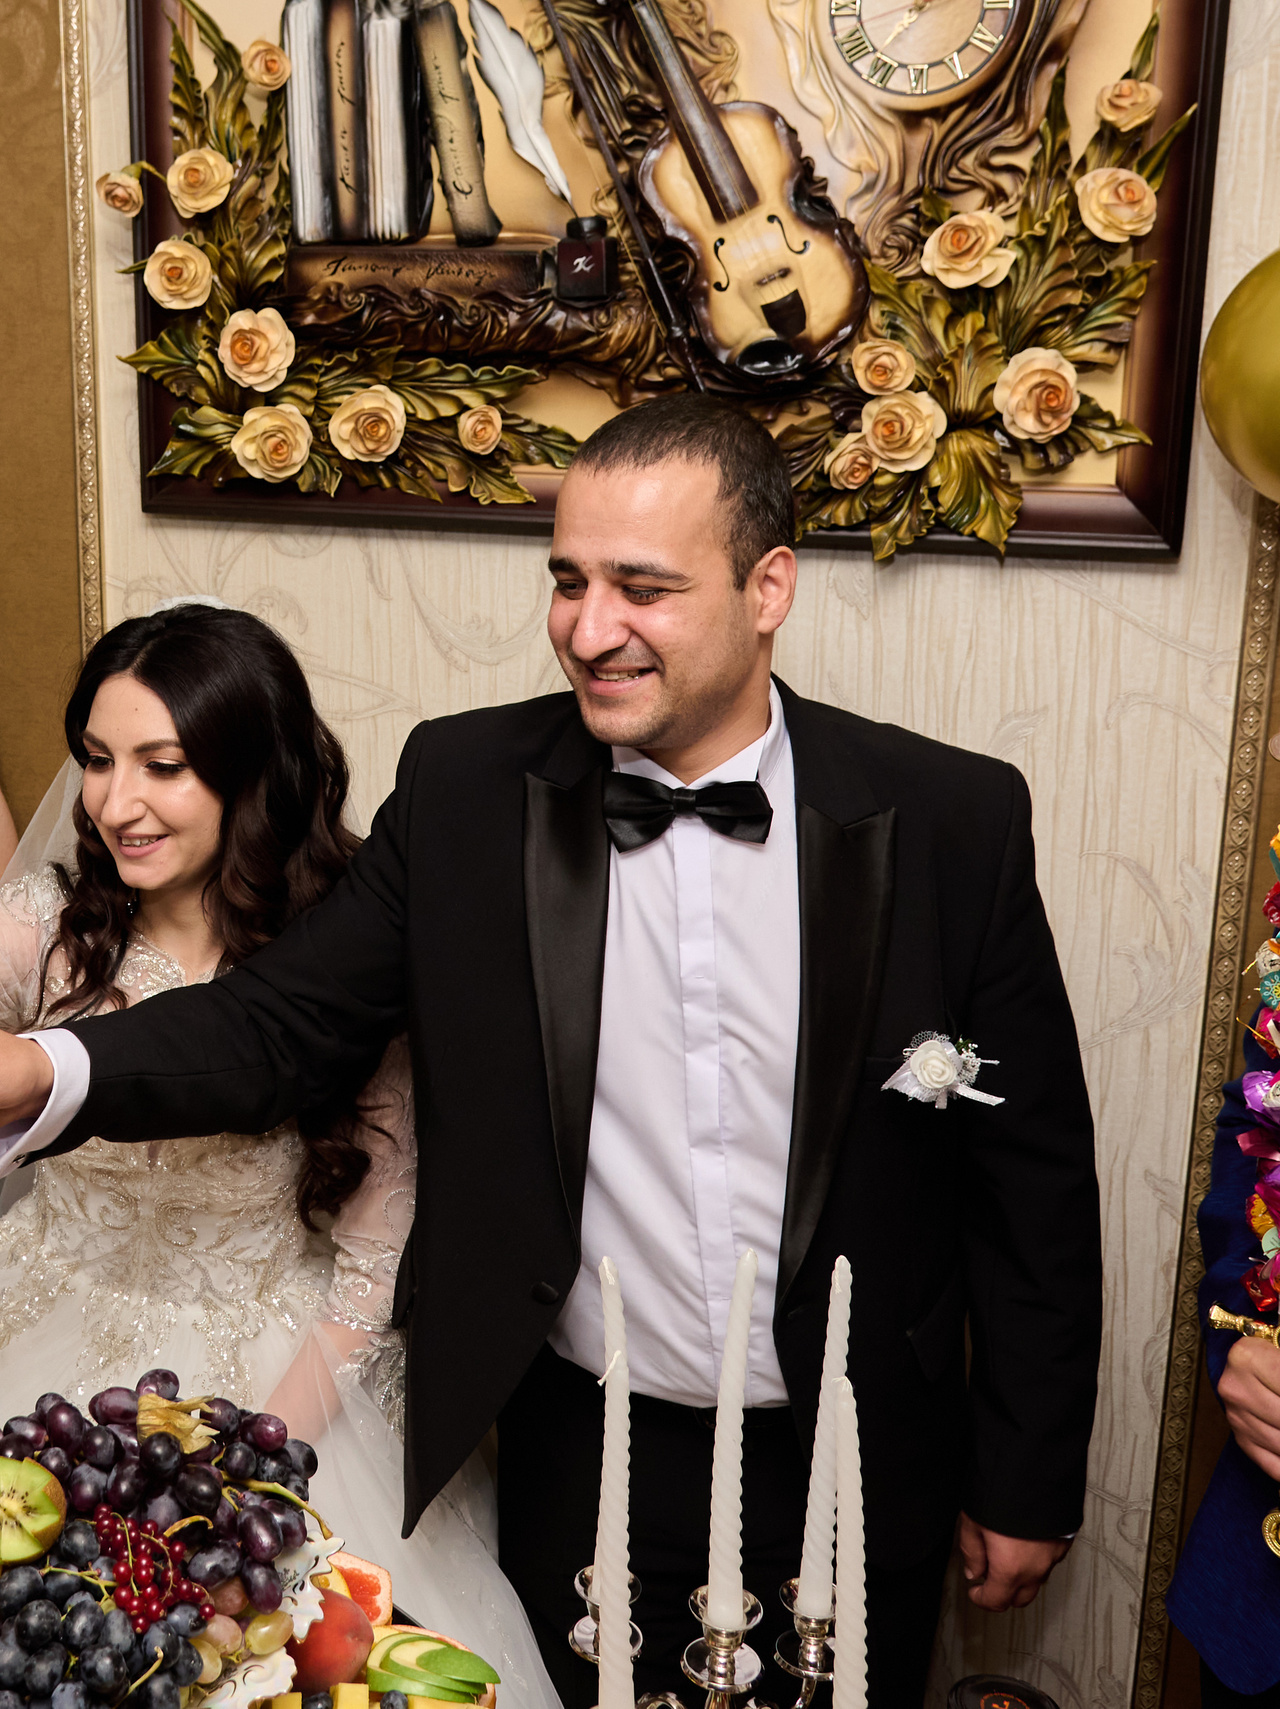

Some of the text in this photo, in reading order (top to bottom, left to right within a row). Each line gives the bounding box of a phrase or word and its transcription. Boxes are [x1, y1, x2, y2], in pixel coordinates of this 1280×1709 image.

[969, 22, 1004, 54] IV
[861, 52, 898, 88] VII
[906, 64, 929, 94] VI
